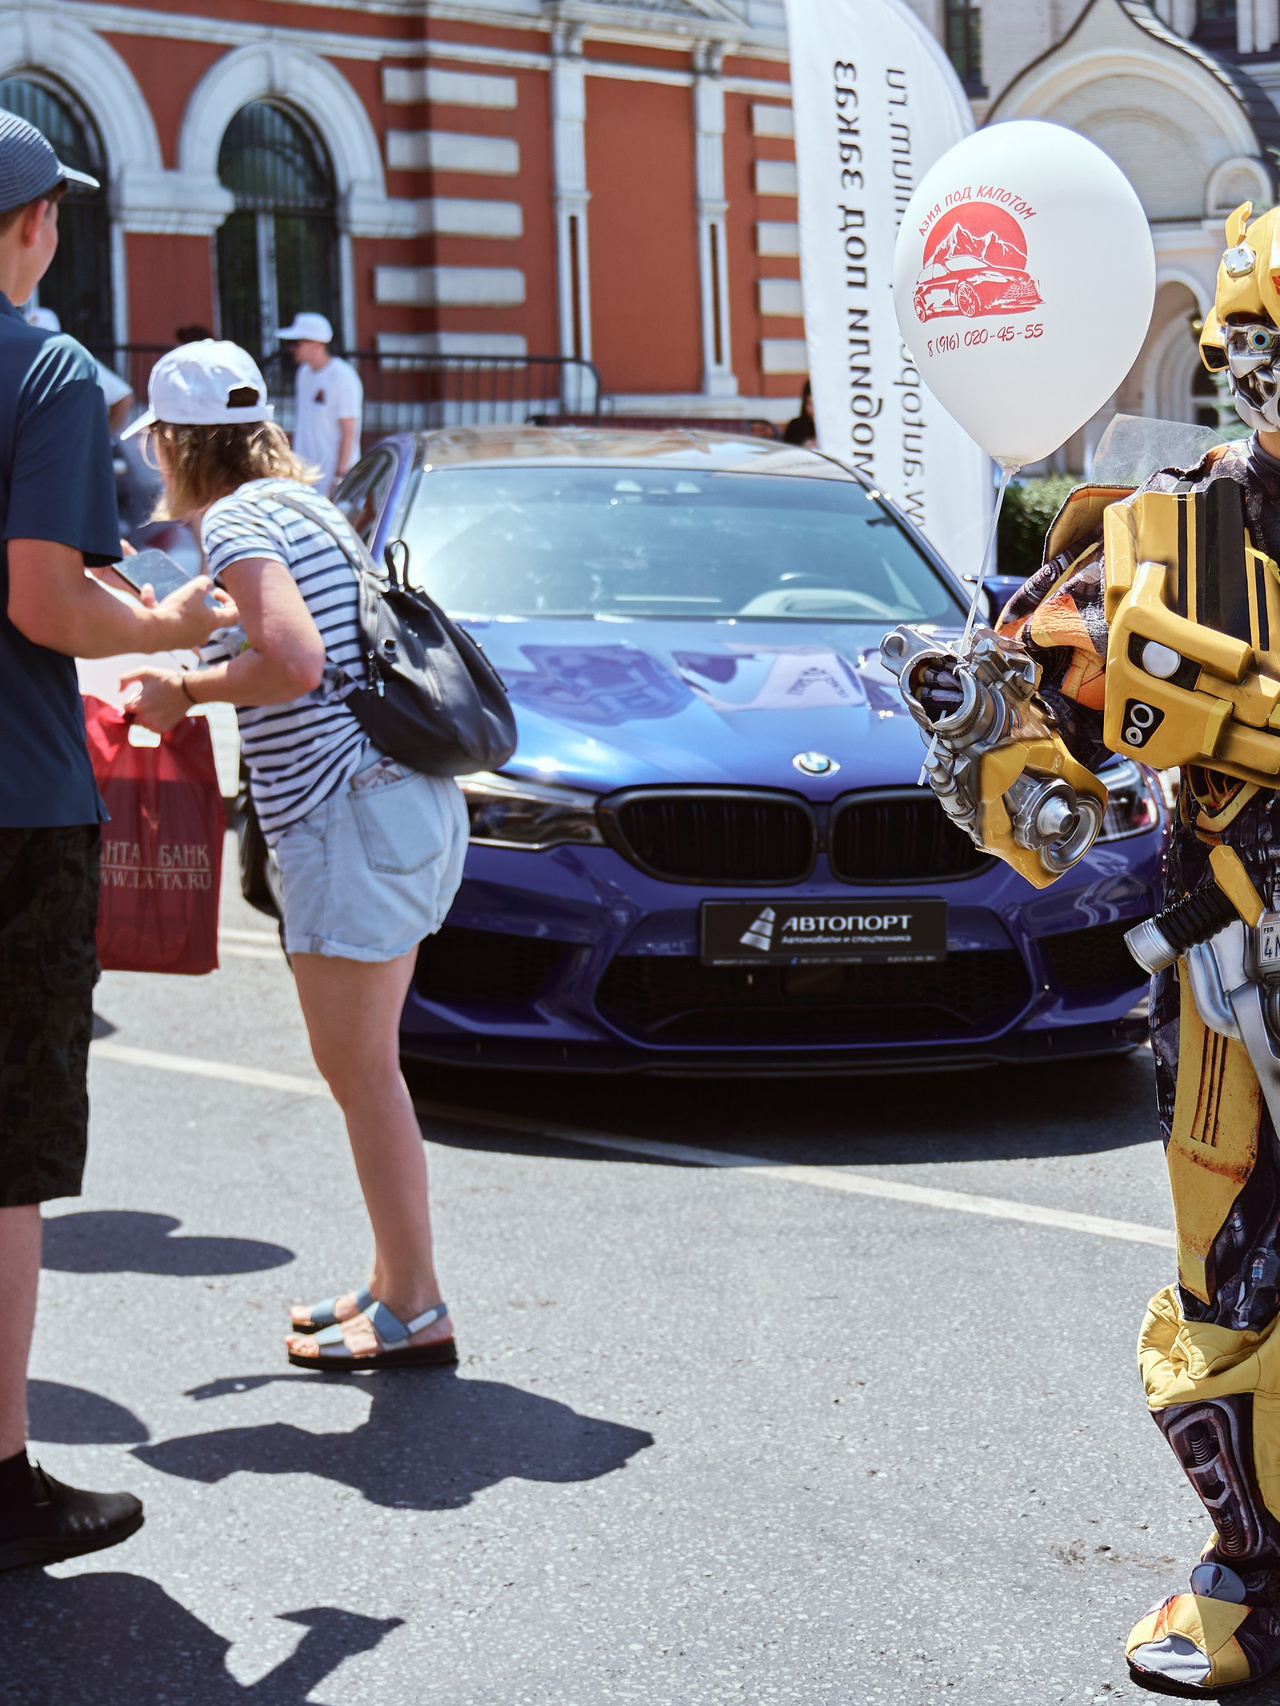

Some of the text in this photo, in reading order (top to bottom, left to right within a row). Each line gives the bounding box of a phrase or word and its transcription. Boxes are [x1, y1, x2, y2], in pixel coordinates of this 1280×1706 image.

[918, 185, 1037, 237] АЗИЯ ПОД КАПОТОМ
[927, 323, 1044, 358] 8 (916) 020-45-55
[100, 841, 210, 868] НТА БАНК
[782, 914, 913, 932] АВТОПОРТ
[781, 935, 842, 945] Автомобили
[852, 934, 912, 944] спецтехника
